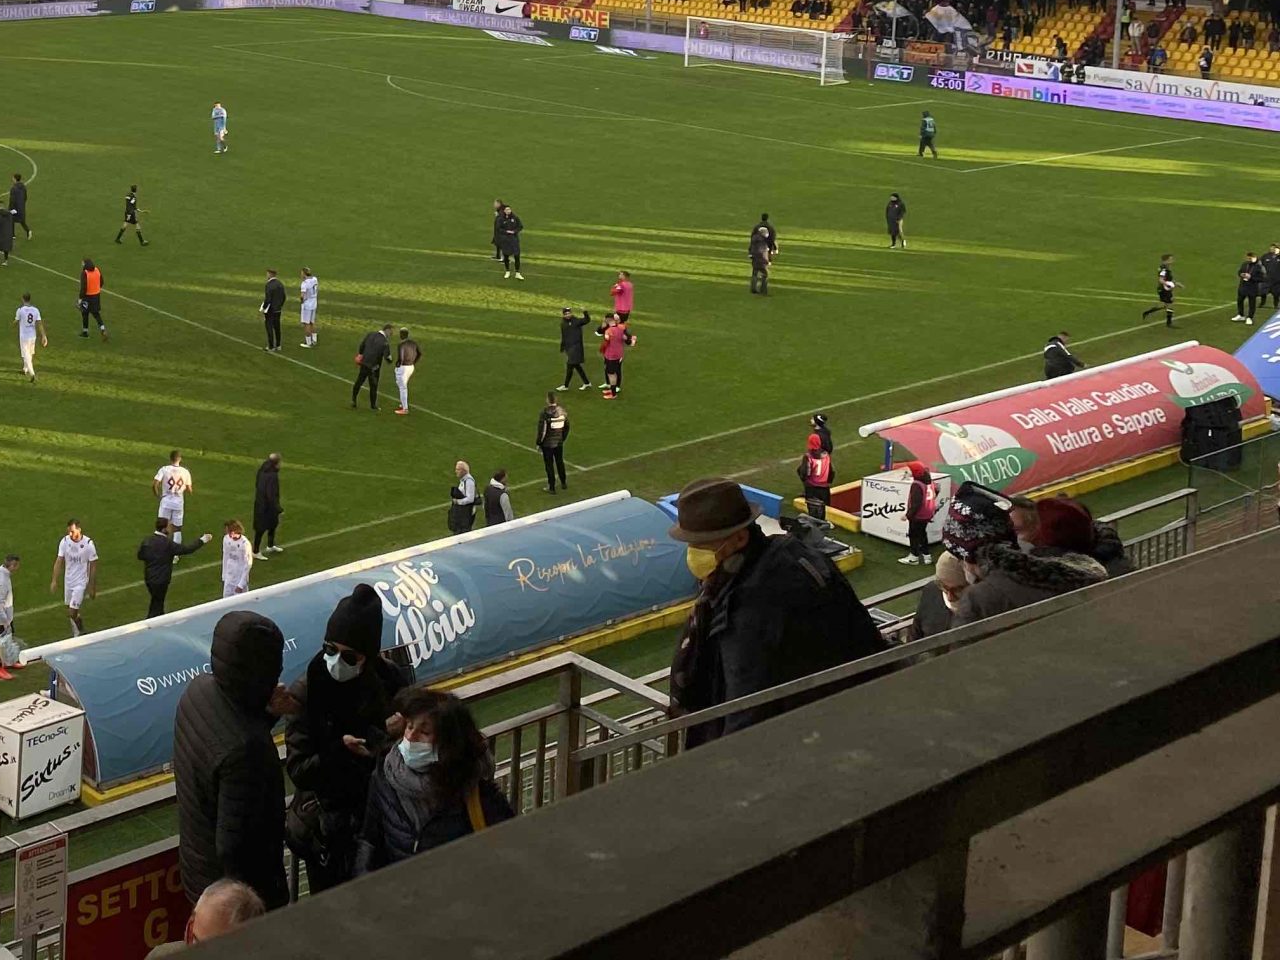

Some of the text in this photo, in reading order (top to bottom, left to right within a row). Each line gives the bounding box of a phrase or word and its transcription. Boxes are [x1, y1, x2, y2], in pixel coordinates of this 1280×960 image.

[130, 0, 155, 12] BKT
[463, 5, 486, 14] WEAR
[571, 29, 597, 41] BKT
[876, 65, 912, 80] BKT
[931, 77, 962, 90] 45:00
[991, 82, 1067, 104] Bambini
[27, 313, 34, 324] 8
[1010, 381, 1160, 429] Dalla Valle Caudina
[1046, 407, 1167, 455] Natura e Sapore
[960, 454, 1022, 486] MAURO
[167, 476, 184, 490] 99
[862, 501, 906, 520] Sixtus
[577, 544, 597, 568] la
[77, 864, 184, 927] SETTO
[143, 907, 169, 949] G
